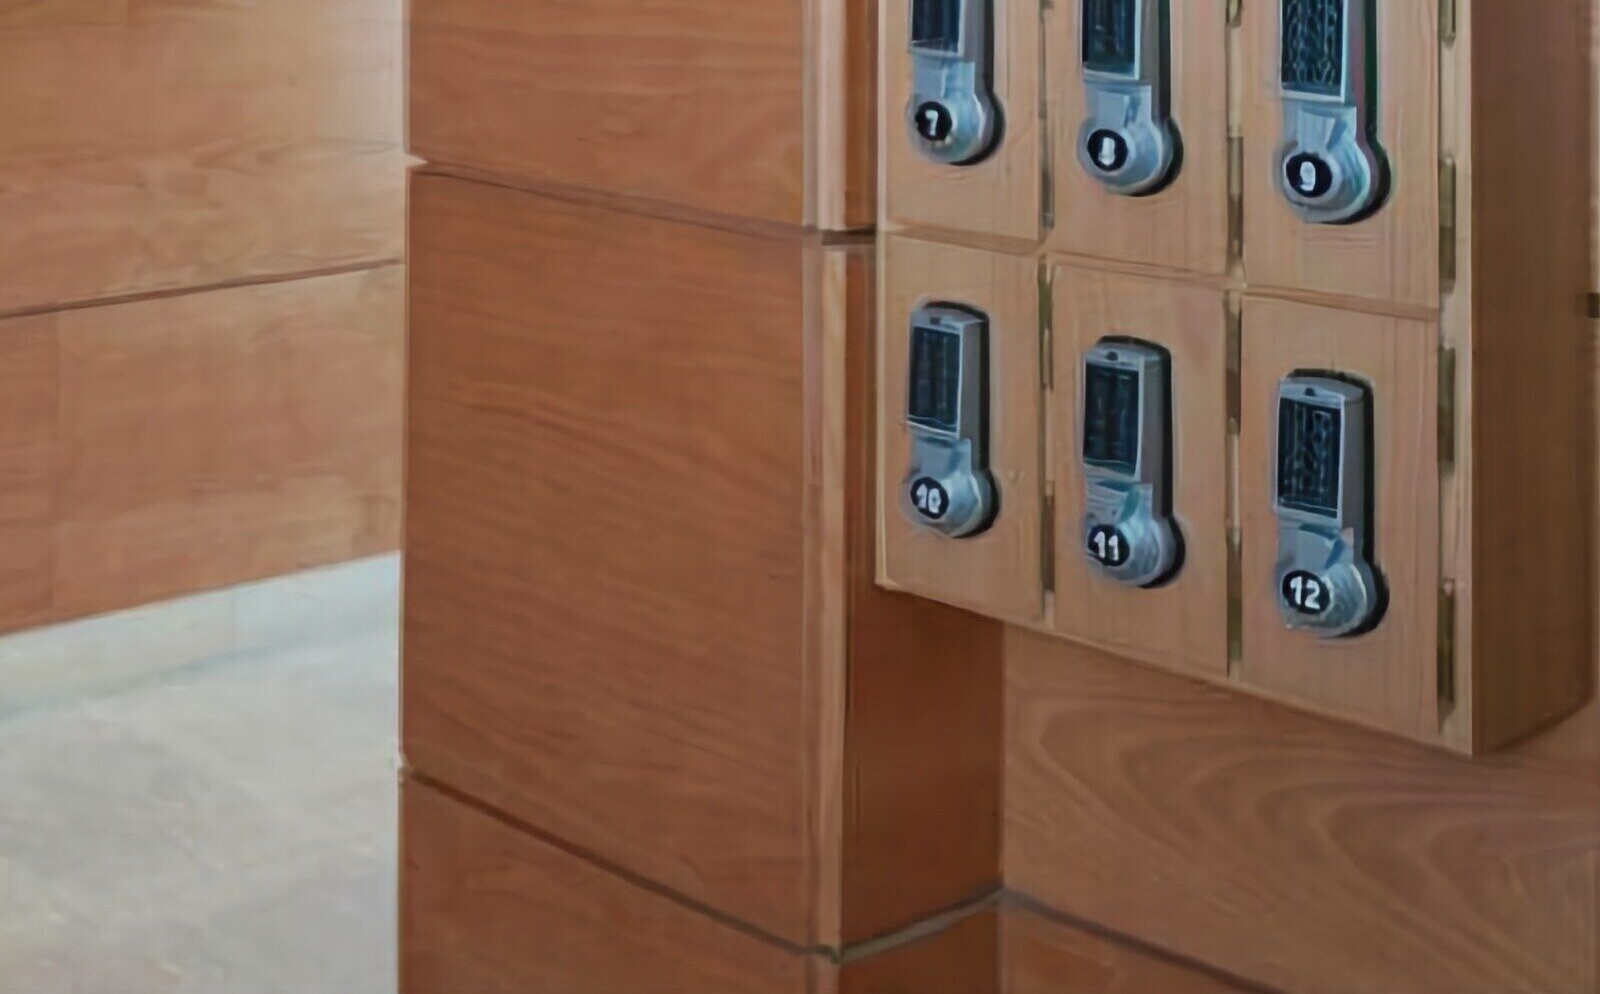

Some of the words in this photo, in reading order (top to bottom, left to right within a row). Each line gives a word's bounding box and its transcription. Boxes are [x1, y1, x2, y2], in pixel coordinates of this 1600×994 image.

[915, 482, 943, 515] 10
[1093, 530, 1120, 562] 11
[1289, 574, 1322, 611] 12
